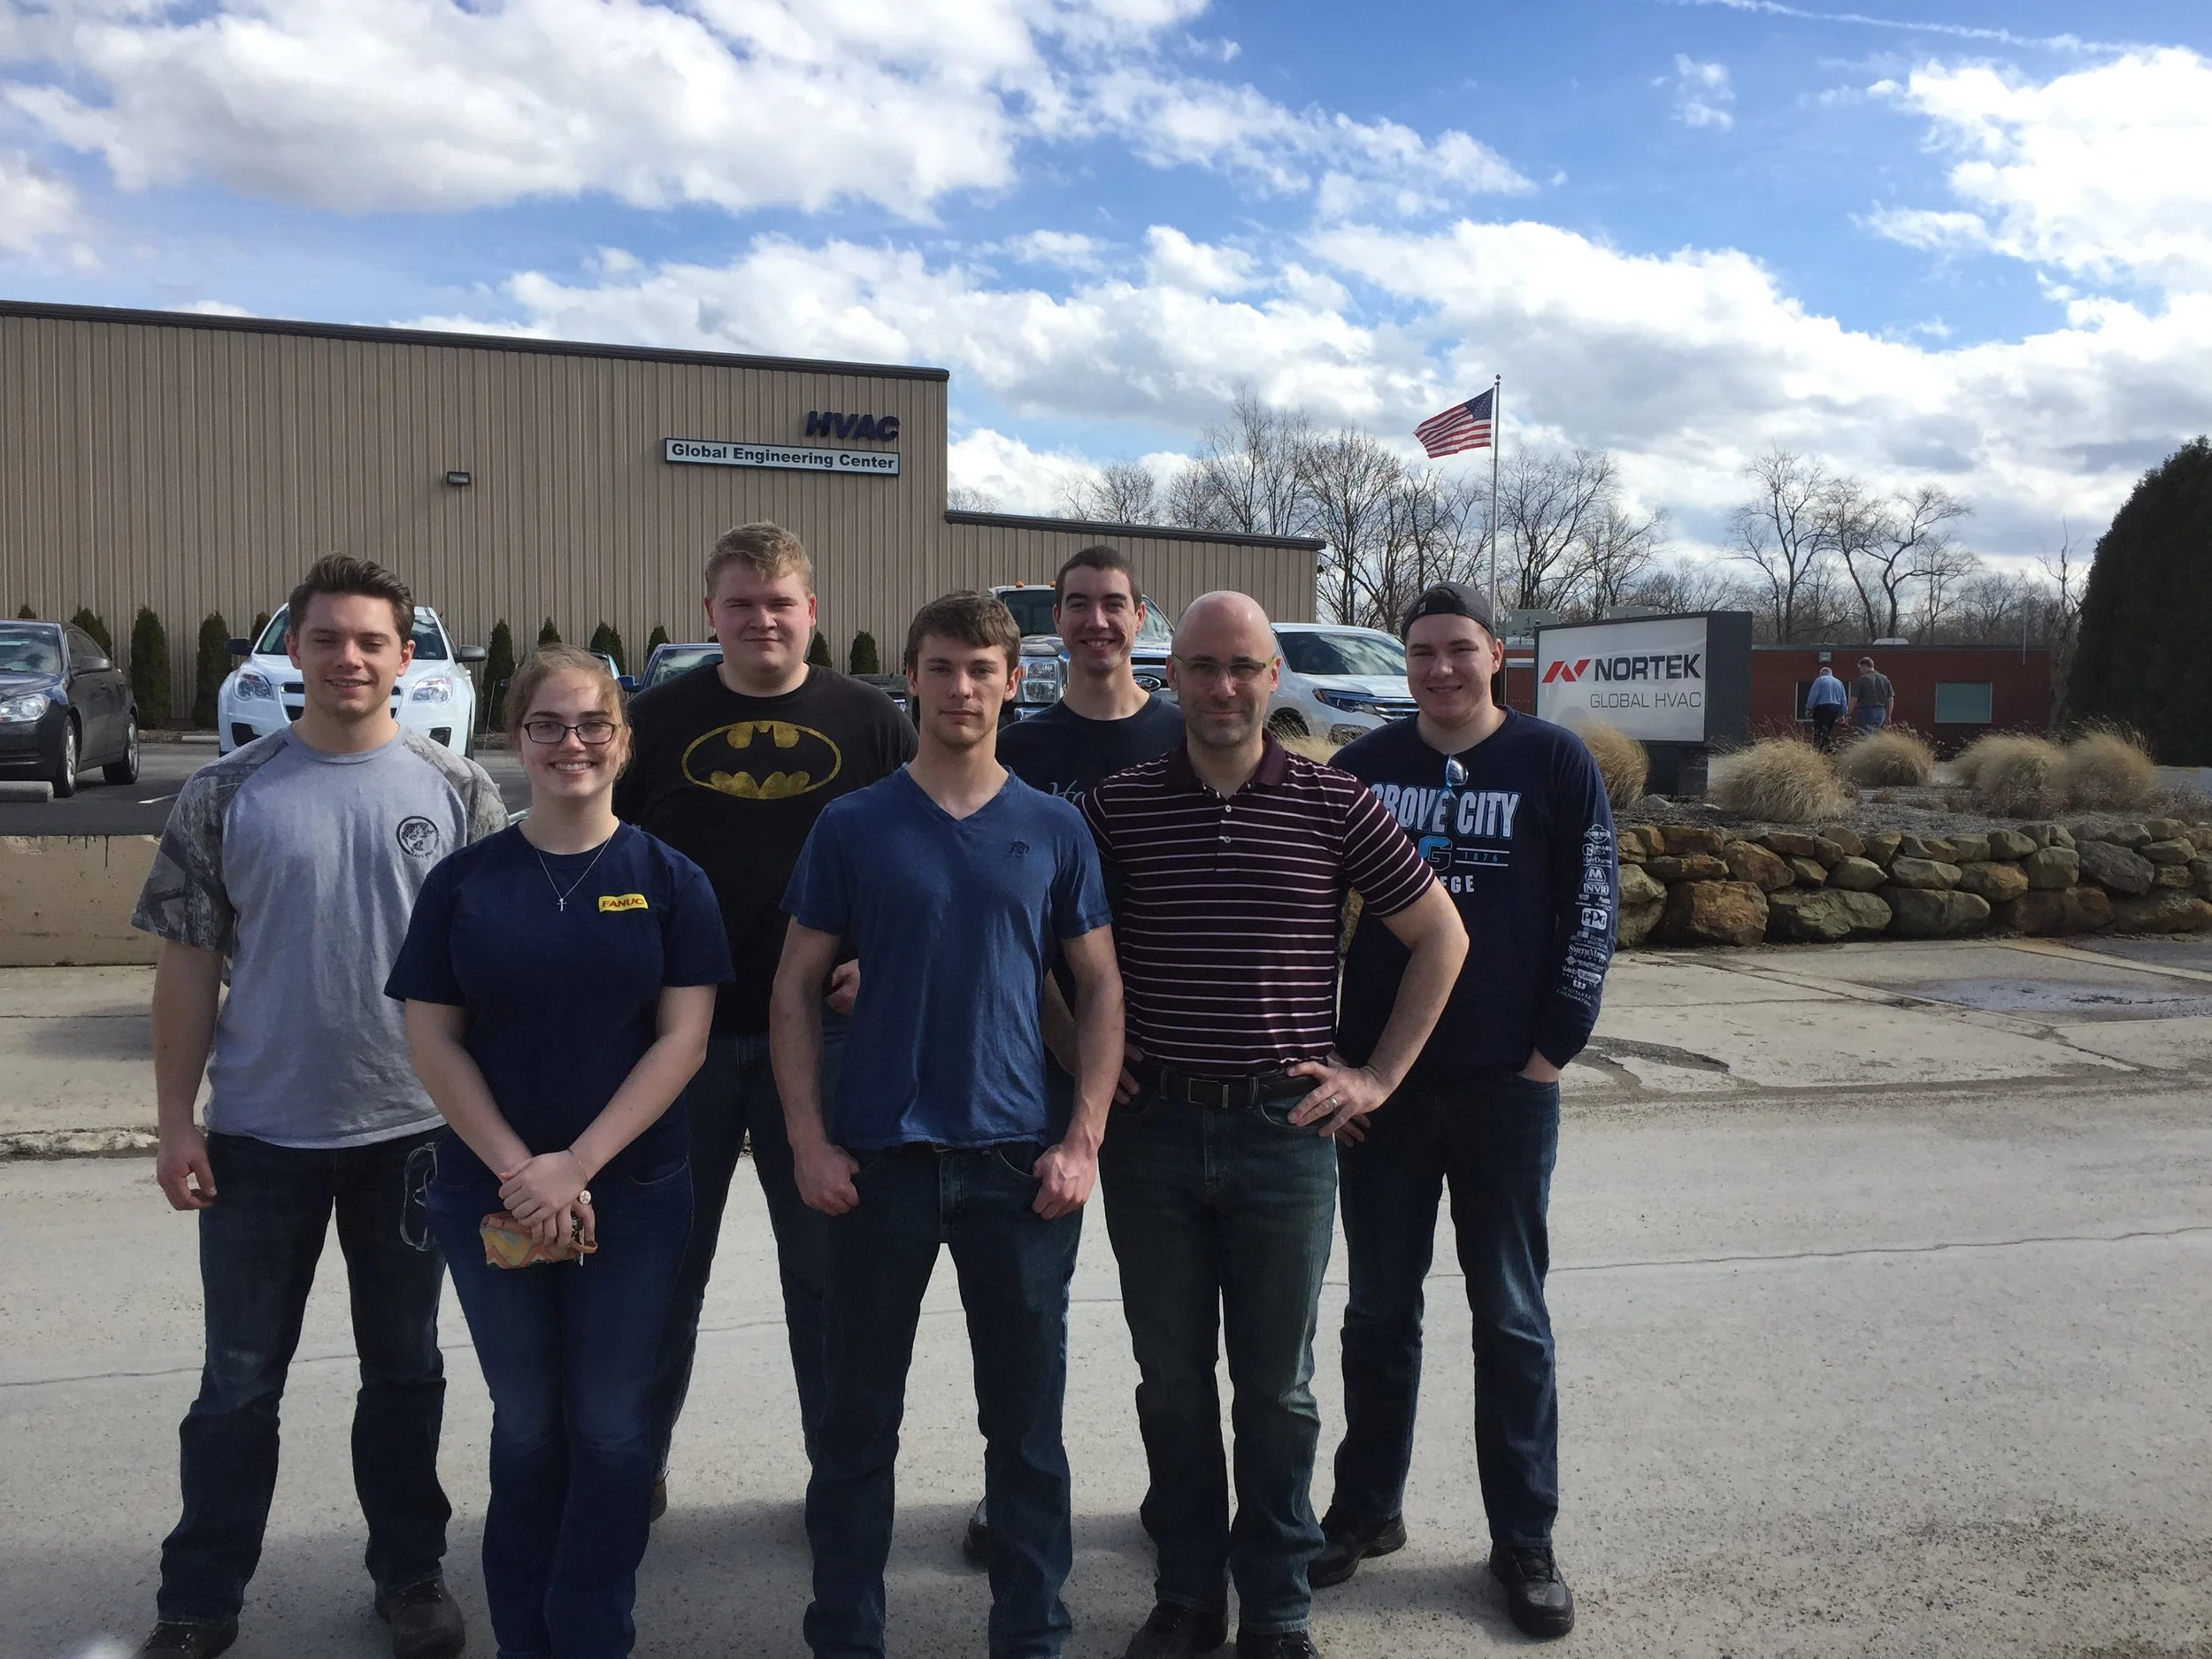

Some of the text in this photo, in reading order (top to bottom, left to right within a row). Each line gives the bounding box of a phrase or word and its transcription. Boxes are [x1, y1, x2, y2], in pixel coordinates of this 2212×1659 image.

[805, 411, 901, 442] HVAC
[672, 443, 895, 470] Global Engineering Center
[1594, 653, 1701, 681] NORTEK
[1590, 692, 1701, 708] GLOBAL HVAC
[1455, 790, 1520, 838] CITY
[1464, 851, 1499, 863] 1876
[1586, 884, 1607, 895] NVR
[602, 898, 645, 908] FANUC
